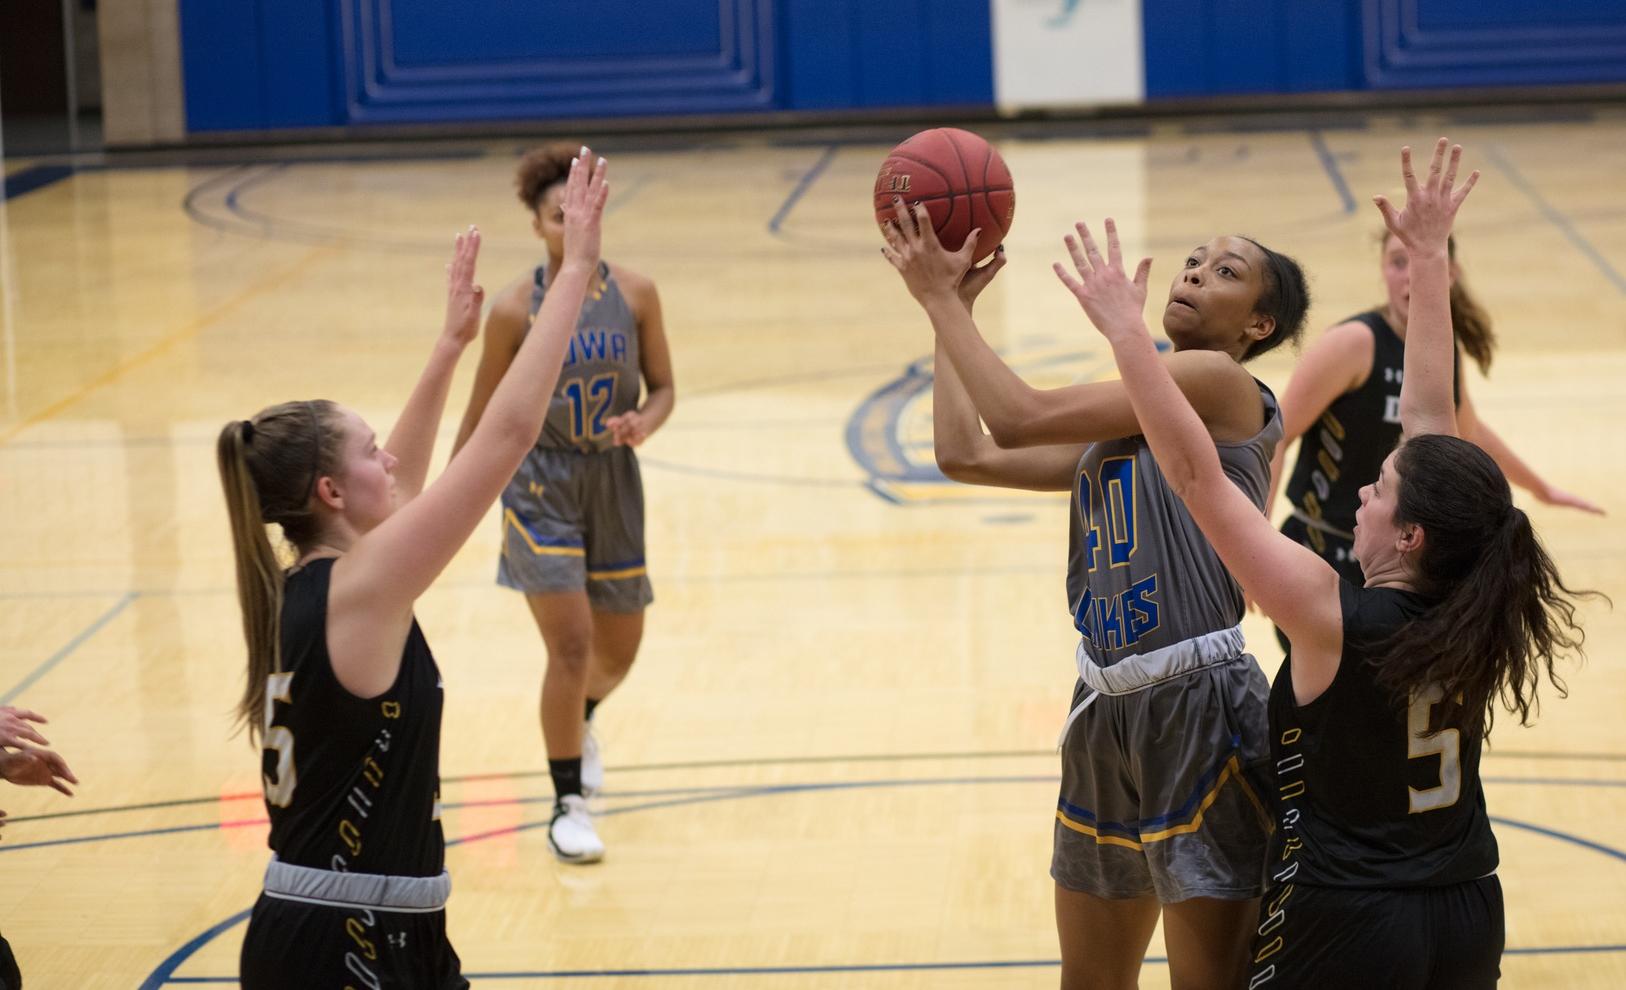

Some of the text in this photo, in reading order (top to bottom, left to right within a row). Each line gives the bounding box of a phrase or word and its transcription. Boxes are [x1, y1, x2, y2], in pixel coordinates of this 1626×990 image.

[566, 329, 627, 365] WA
[562, 371, 620, 444] 12
[1078, 454, 1137, 573] 40
[1407, 682, 1463, 815] 5
